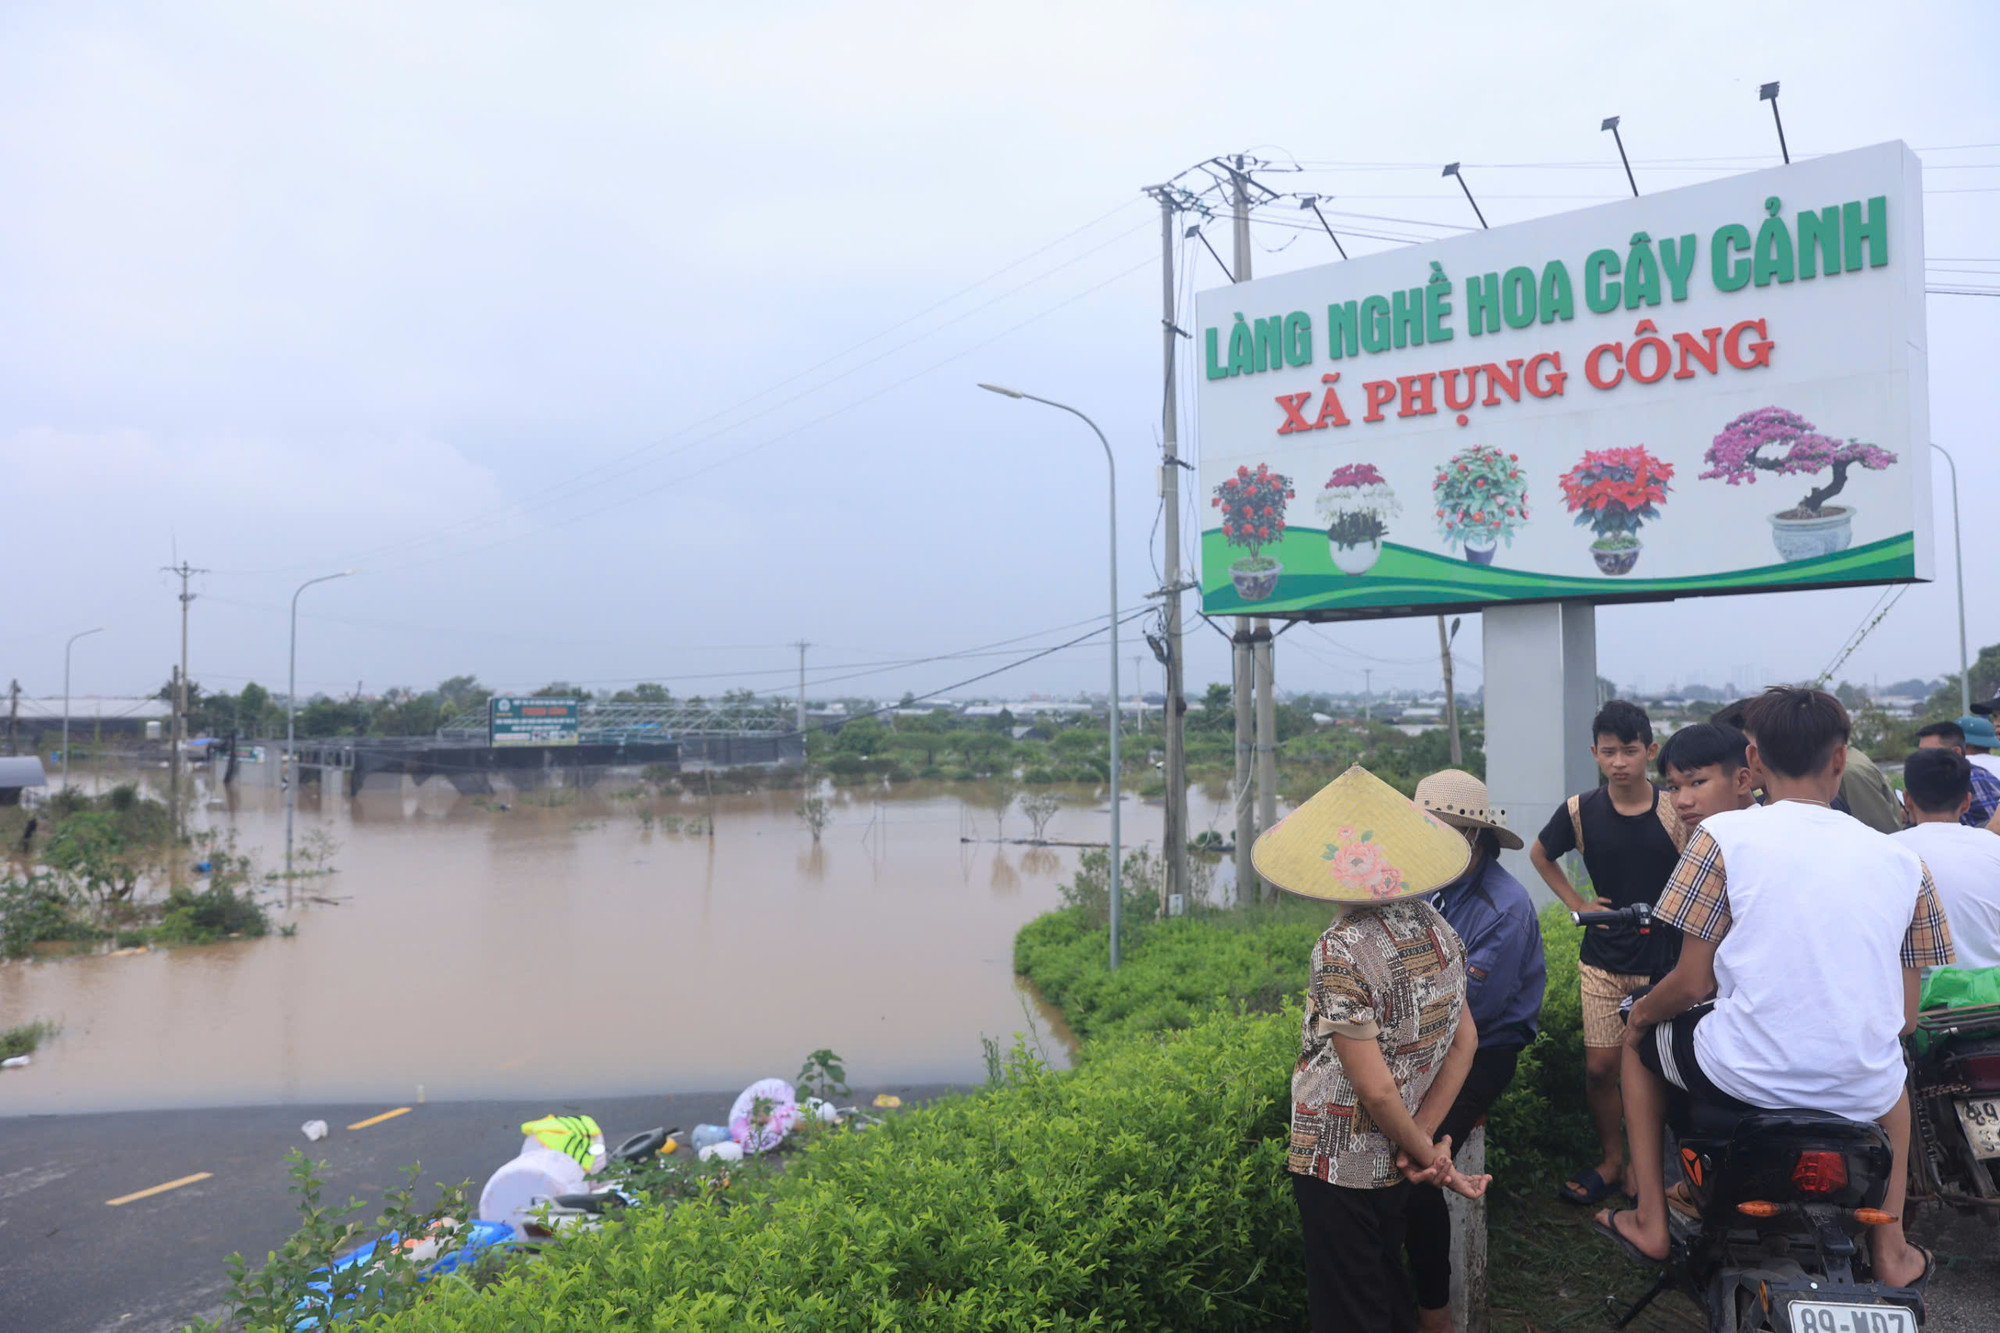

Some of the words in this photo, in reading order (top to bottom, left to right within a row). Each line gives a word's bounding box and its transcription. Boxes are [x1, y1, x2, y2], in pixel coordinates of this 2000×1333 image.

[1205, 312, 1312, 380] LÀNG
[1328, 261, 1454, 360] NGHỀ
[1466, 260, 1574, 336] HOA
[1585, 231, 1697, 314] CÂY
[1711, 196, 1888, 292] CẢNH
[1275, 372, 1350, 434] XÃ
[1362, 351, 1568, 426] PHỤNG
[1584, 318, 1775, 389] CÔNG
